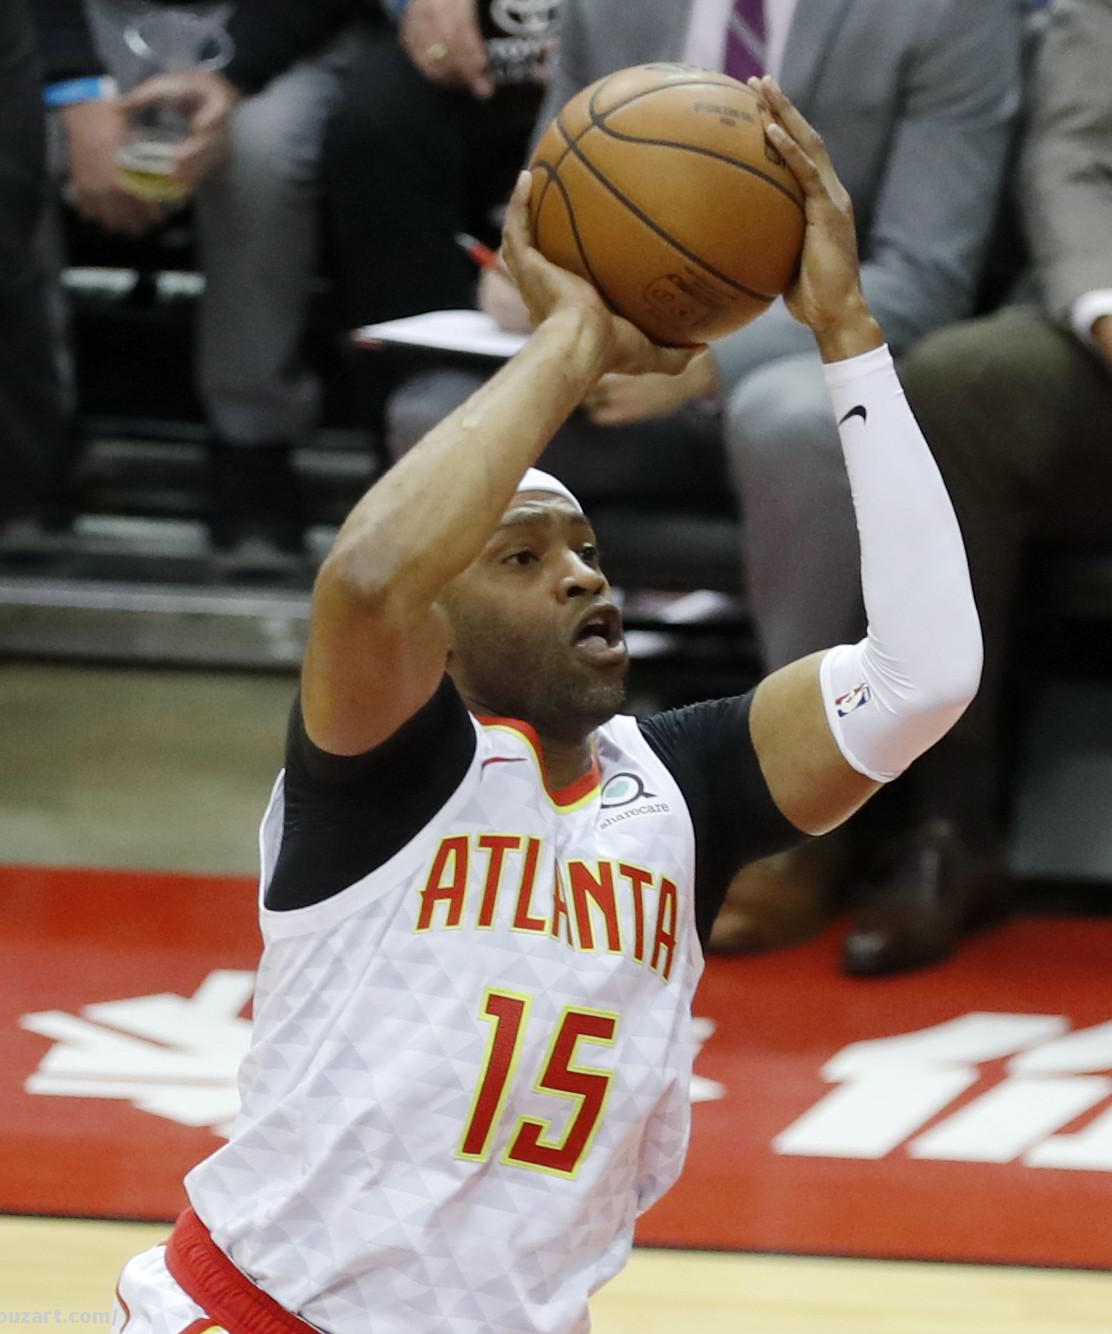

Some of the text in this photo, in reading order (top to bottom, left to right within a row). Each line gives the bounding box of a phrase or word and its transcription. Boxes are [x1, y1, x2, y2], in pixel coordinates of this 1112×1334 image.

[599, 802, 670, 830] sharecare
[413, 833, 679, 983] ATLANTA
[453, 986, 620, 1181] 15
